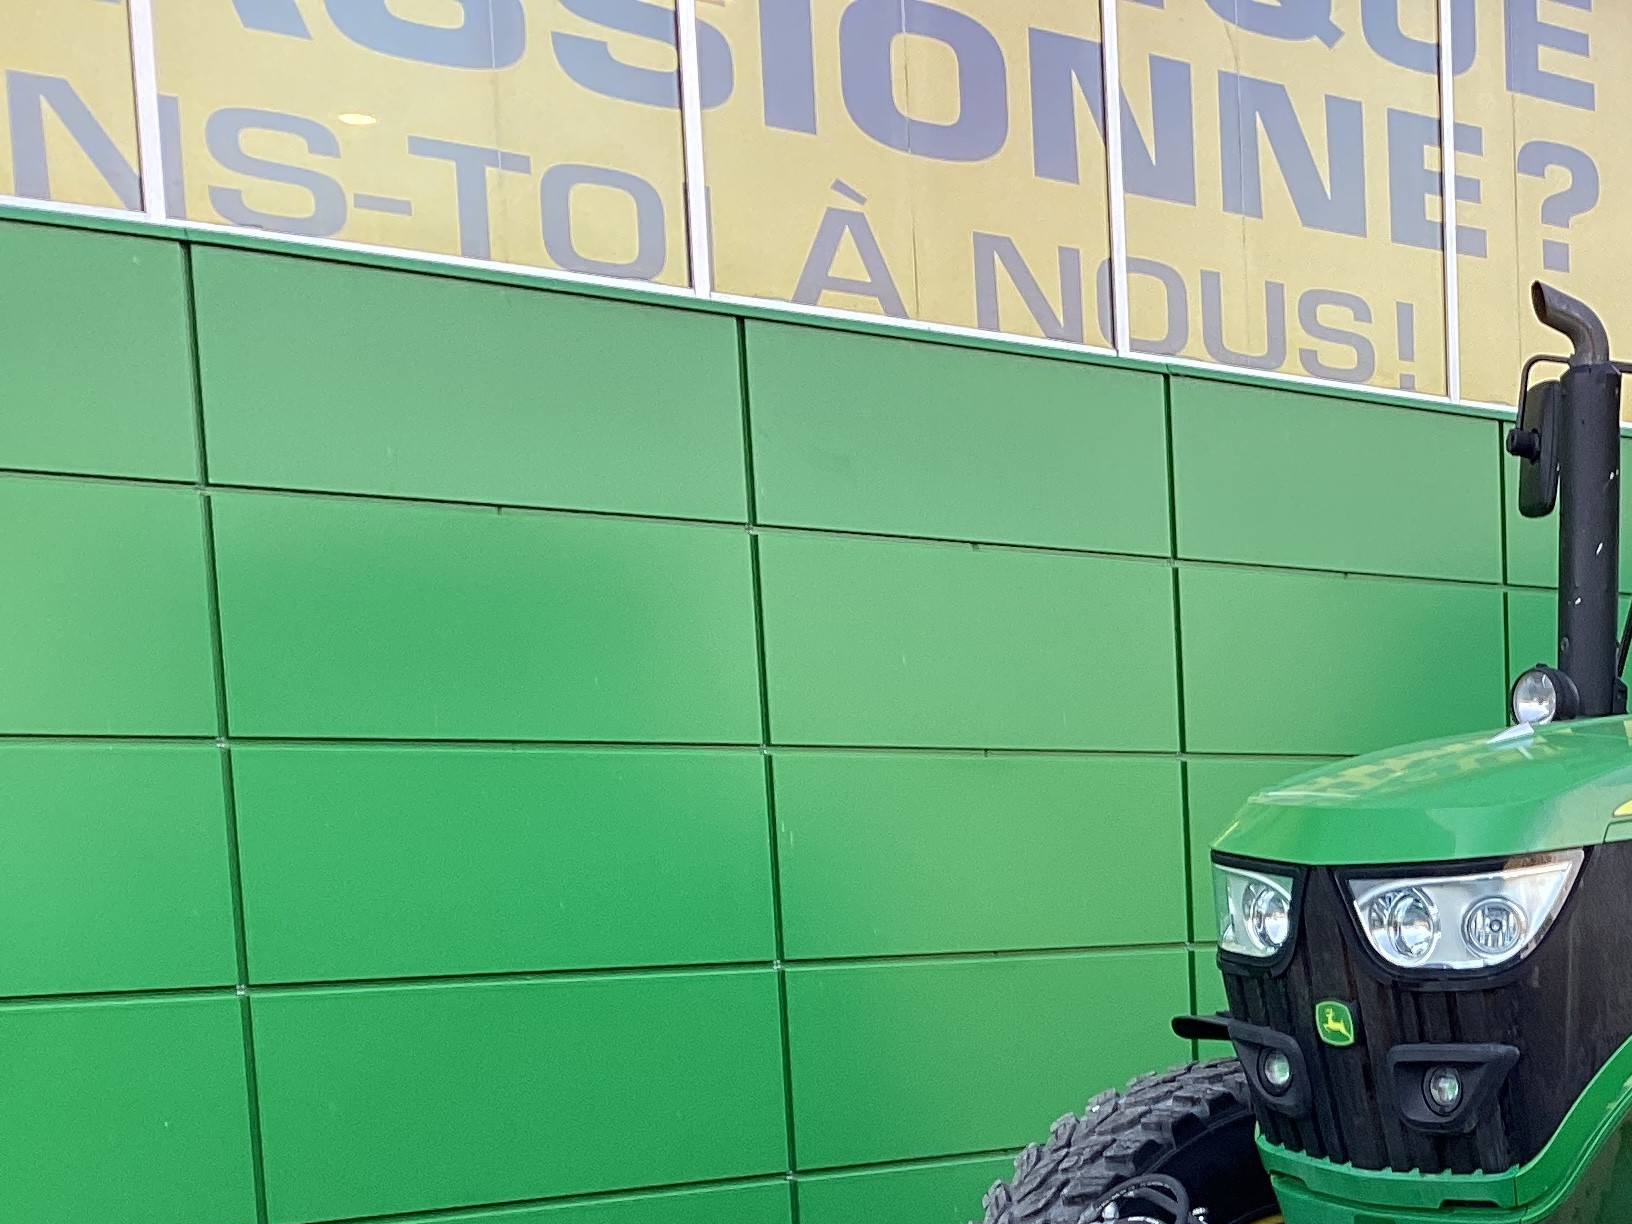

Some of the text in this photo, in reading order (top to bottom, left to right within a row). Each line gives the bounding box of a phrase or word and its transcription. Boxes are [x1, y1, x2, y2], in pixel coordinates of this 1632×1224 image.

[5, 68, 1416, 390] NS-TO À NOUS!
